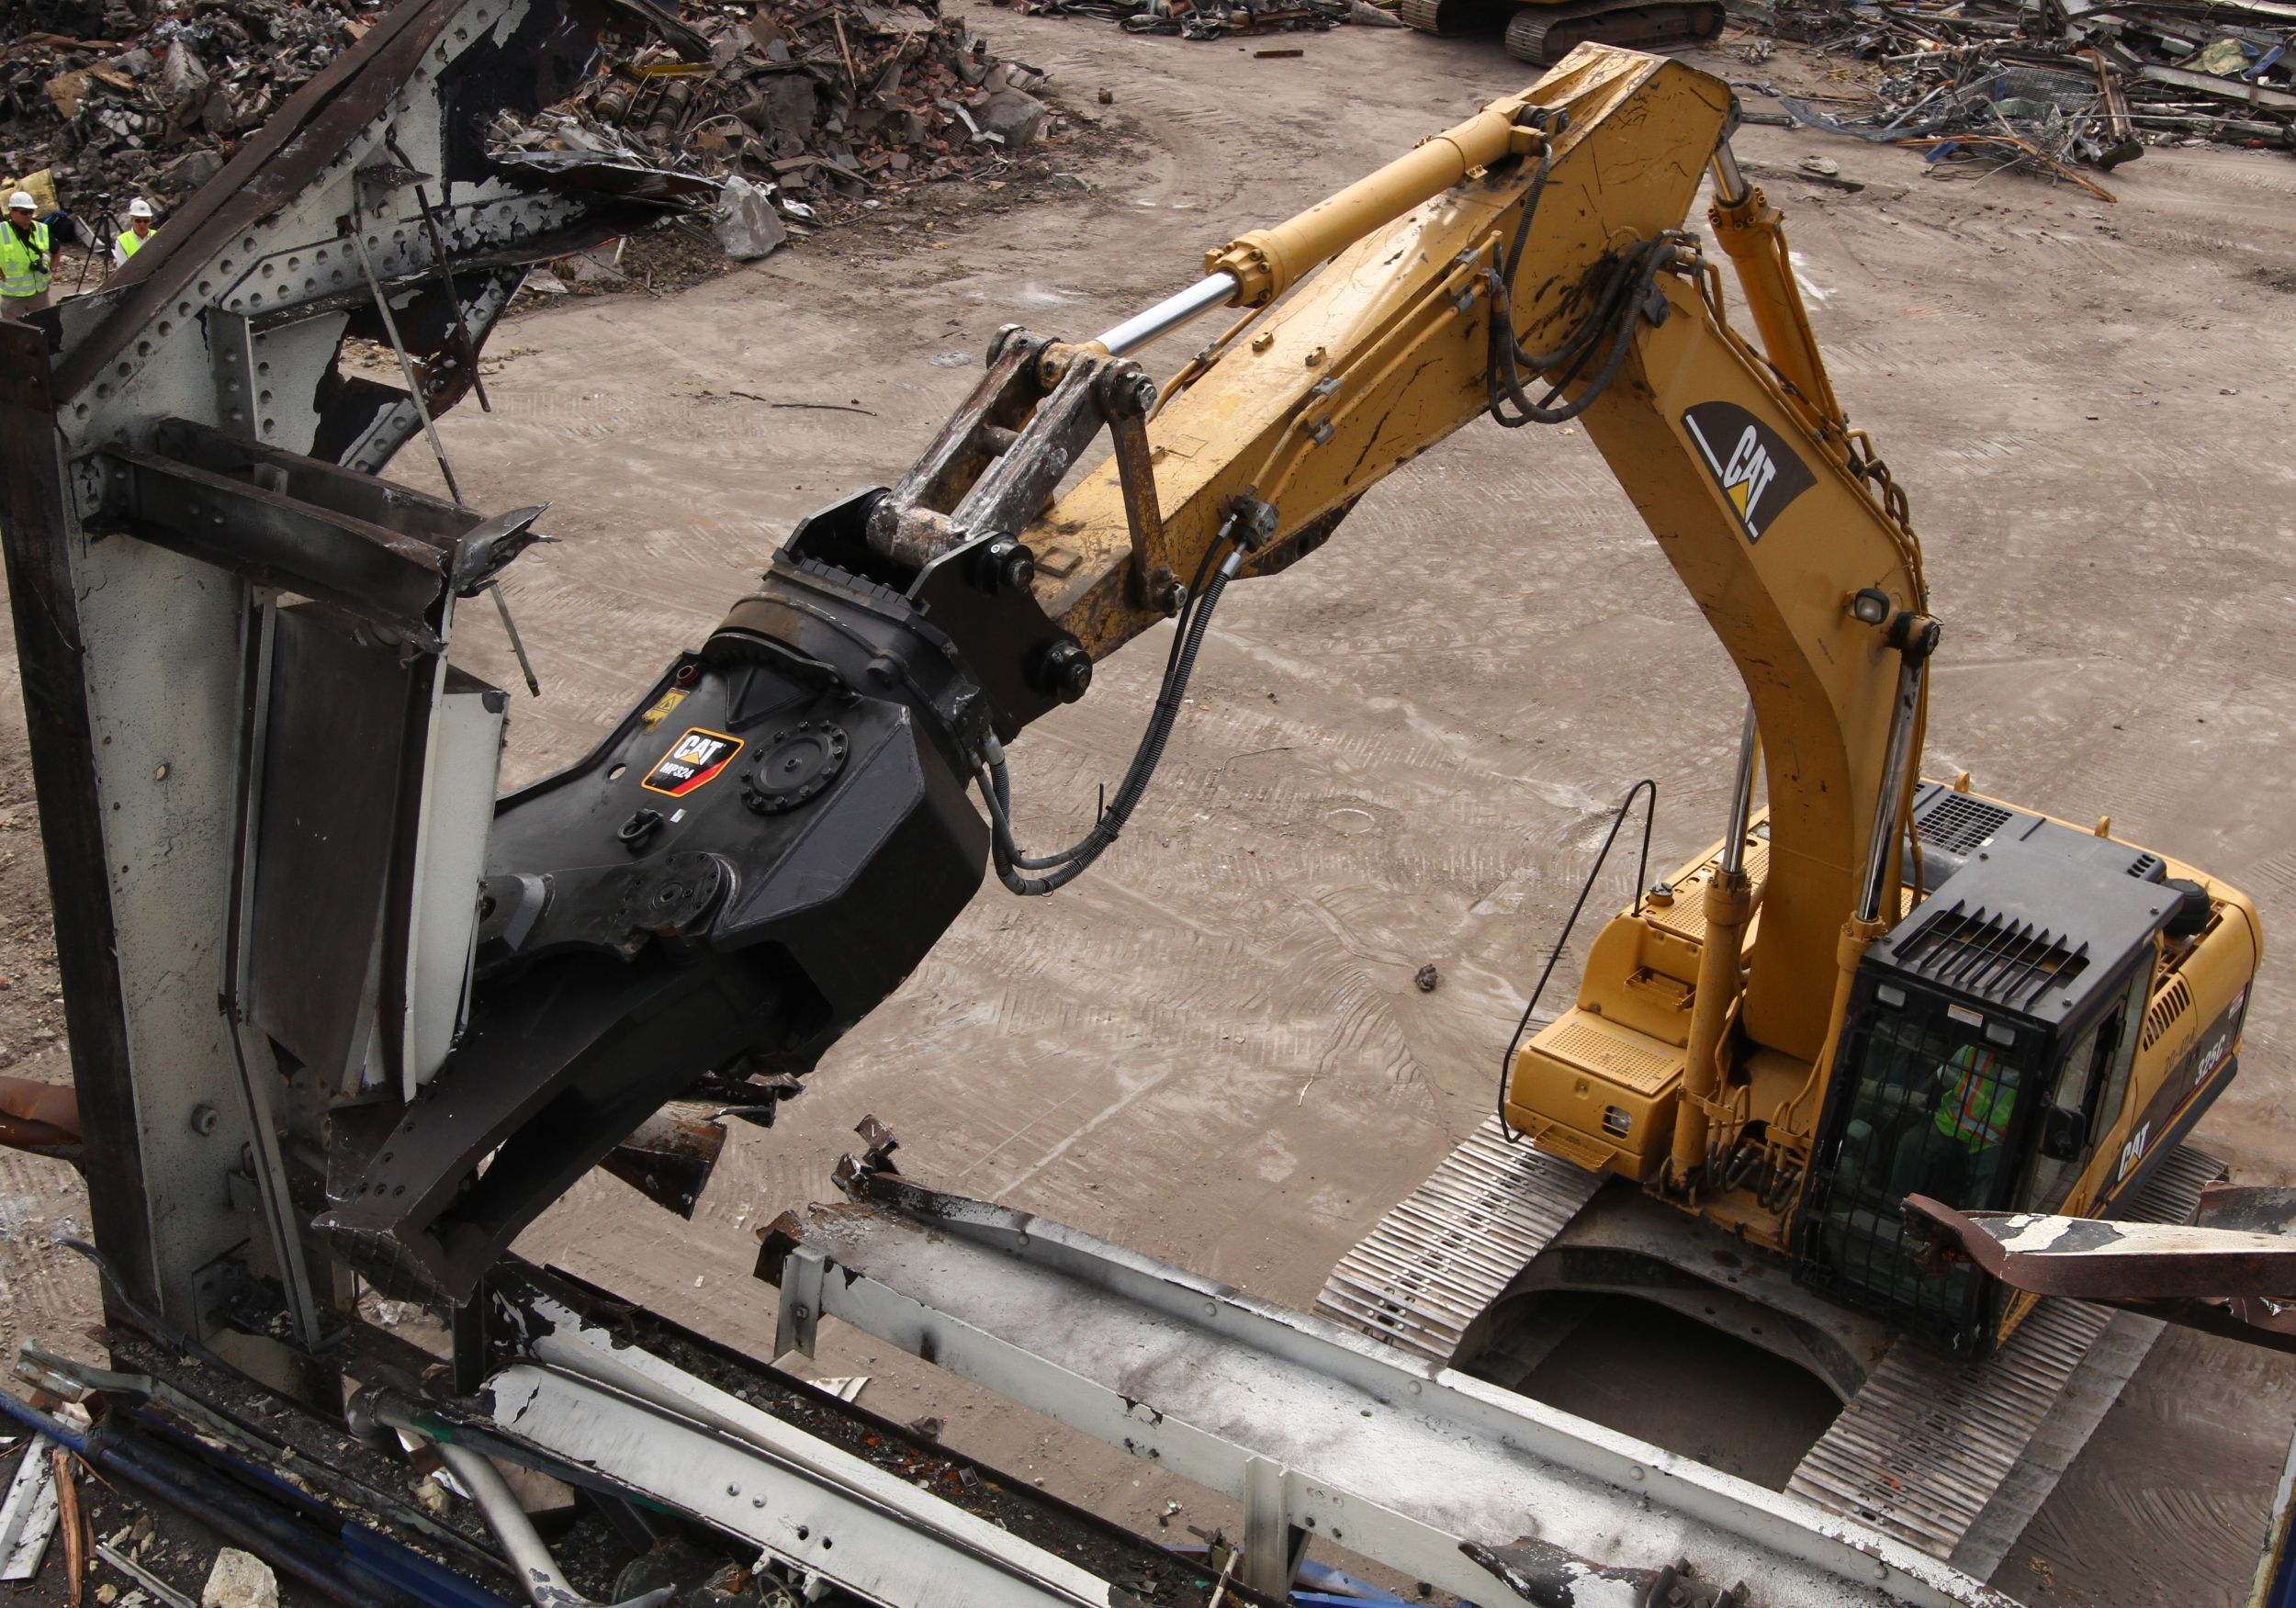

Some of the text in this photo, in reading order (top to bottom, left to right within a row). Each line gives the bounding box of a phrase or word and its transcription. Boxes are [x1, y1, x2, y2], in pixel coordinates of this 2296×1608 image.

[1723, 425, 1776, 523] CAT
[659, 761, 695, 780] MP324
[673, 735, 724, 765] CAT
[2195, 1034, 2226, 1085] 325C
[2118, 1121, 2150, 1182] CAT
